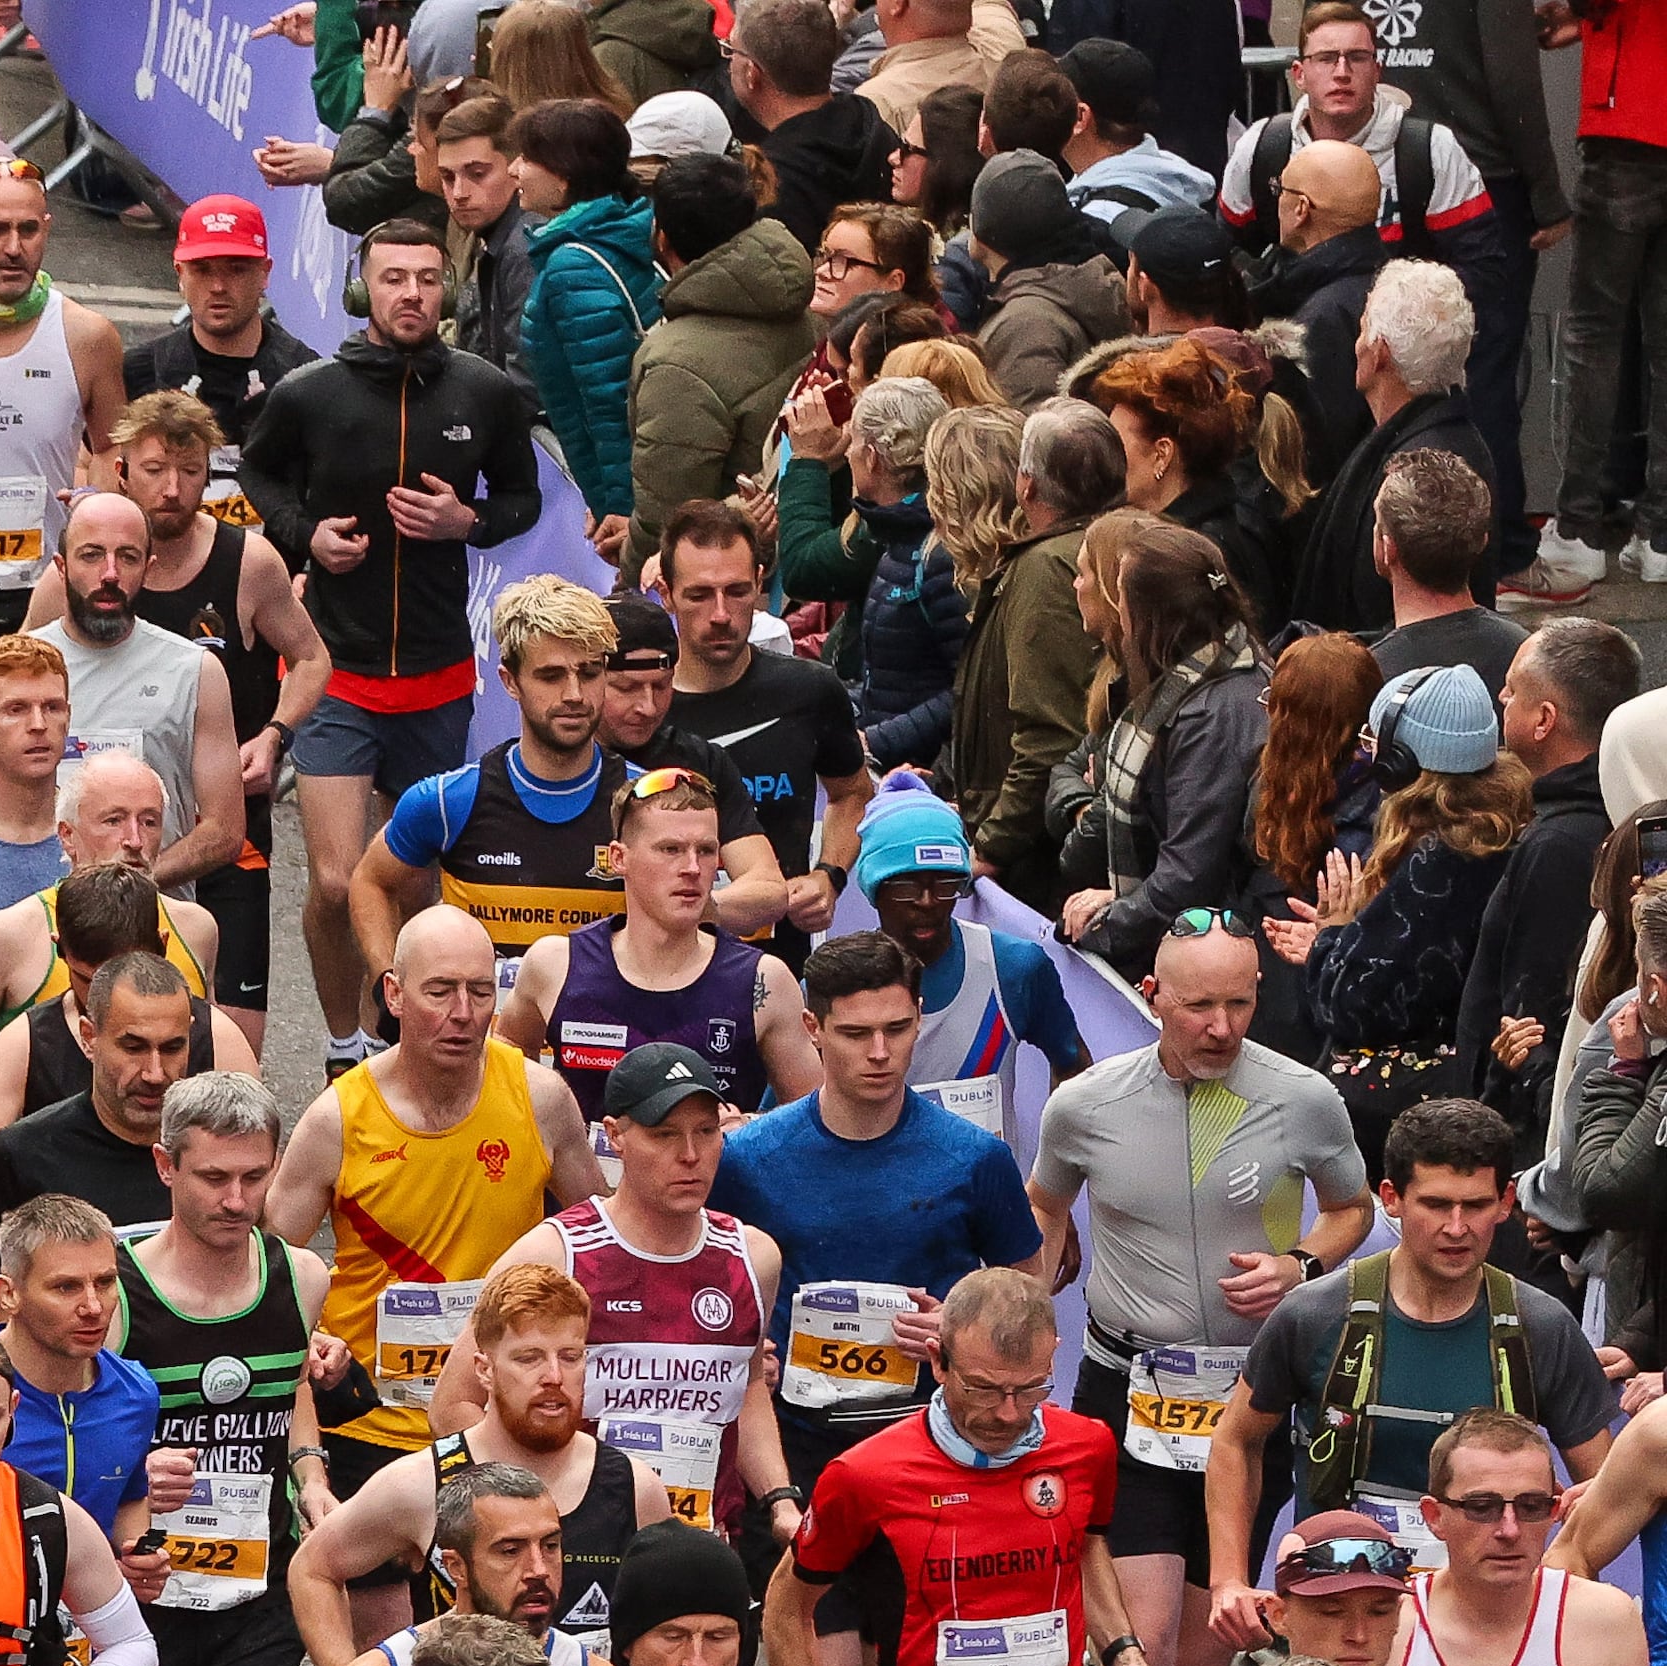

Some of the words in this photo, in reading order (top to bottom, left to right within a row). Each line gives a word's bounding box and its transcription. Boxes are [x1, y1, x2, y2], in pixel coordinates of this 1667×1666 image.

[1387, 47, 1435, 68] RACING
[162, 0, 208, 93] Irish
[204, 40, 255, 141] Life
[218, 212, 238, 224] ONE
[468, 904, 554, 925] BALLYMORE
[563, 1029, 624, 1043] PROGRAMMED
[606, 1300, 643, 1312] KCS
[596, 1357, 732, 1382] MULLINGAR
[818, 1344, 887, 1376] 566
[604, 1388, 721, 1413] HARRIERS
[1174, 1459, 1198, 1470] 1574
[184, 1516, 219, 1526] SEAMUS
[172, 1540, 239, 1571] 722
[927, 1546, 1049, 1583] EDENDERRY
[190, 1597, 211, 1607] 722
